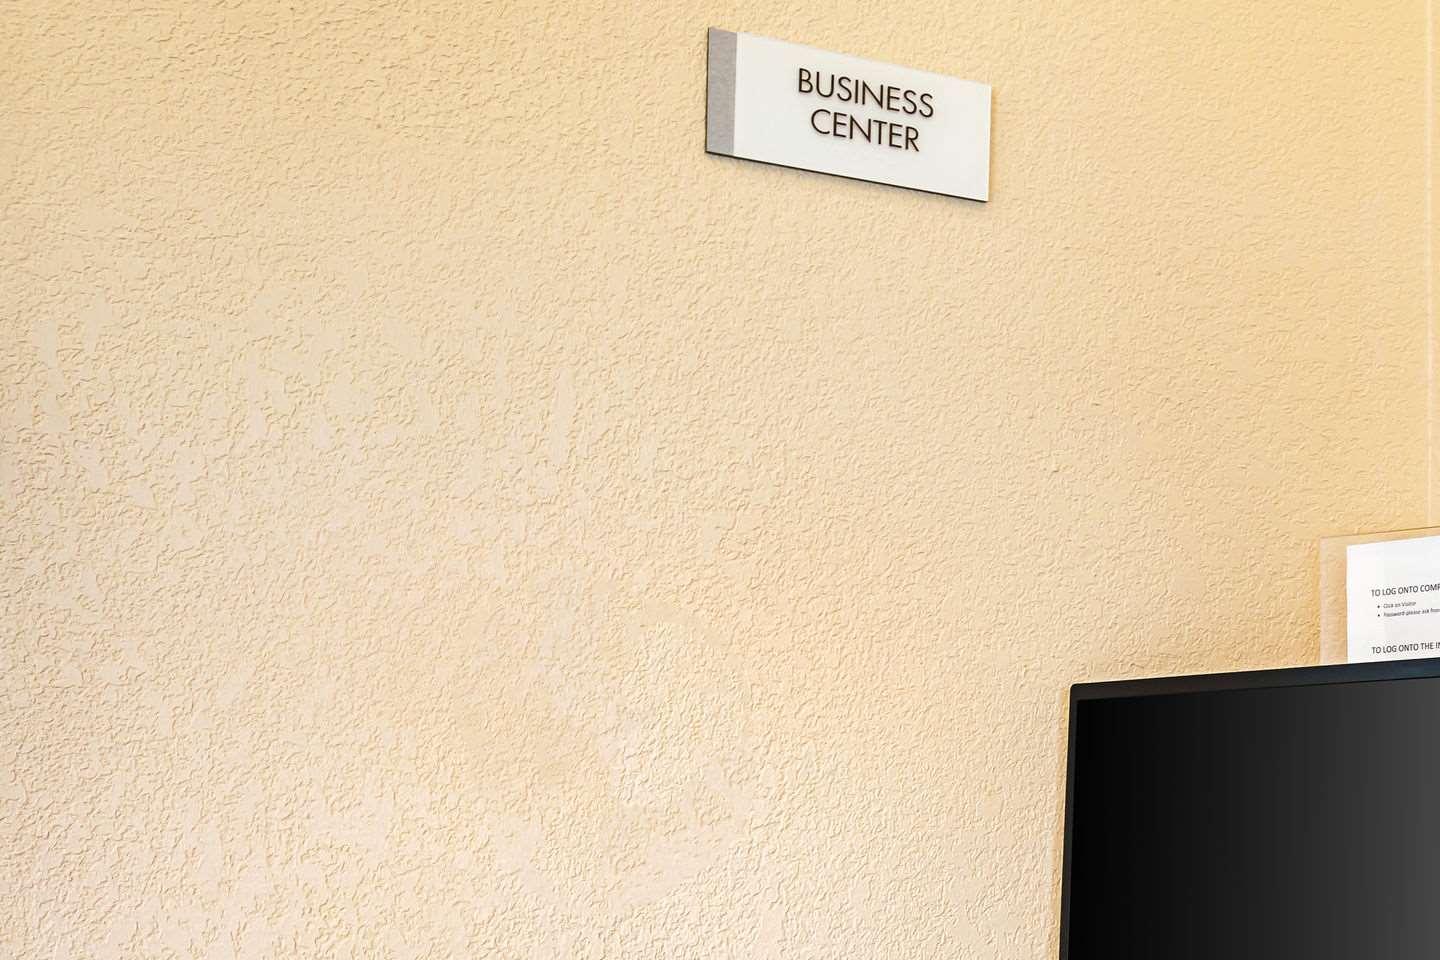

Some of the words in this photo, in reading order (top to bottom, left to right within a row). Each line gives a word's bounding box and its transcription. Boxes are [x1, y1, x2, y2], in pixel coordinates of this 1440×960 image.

[798, 67, 934, 118] BUSINESS
[811, 108, 919, 151] CENTER
[1371, 589, 1381, 597] TO
[1382, 587, 1397, 596] LOG
[1398, 585, 1419, 594] ONTO
[1372, 646, 1382, 654] TO
[1383, 645, 1397, 653] LOG
[1398, 643, 1419, 652] ONTO
[1420, 642, 1435, 650] THE
